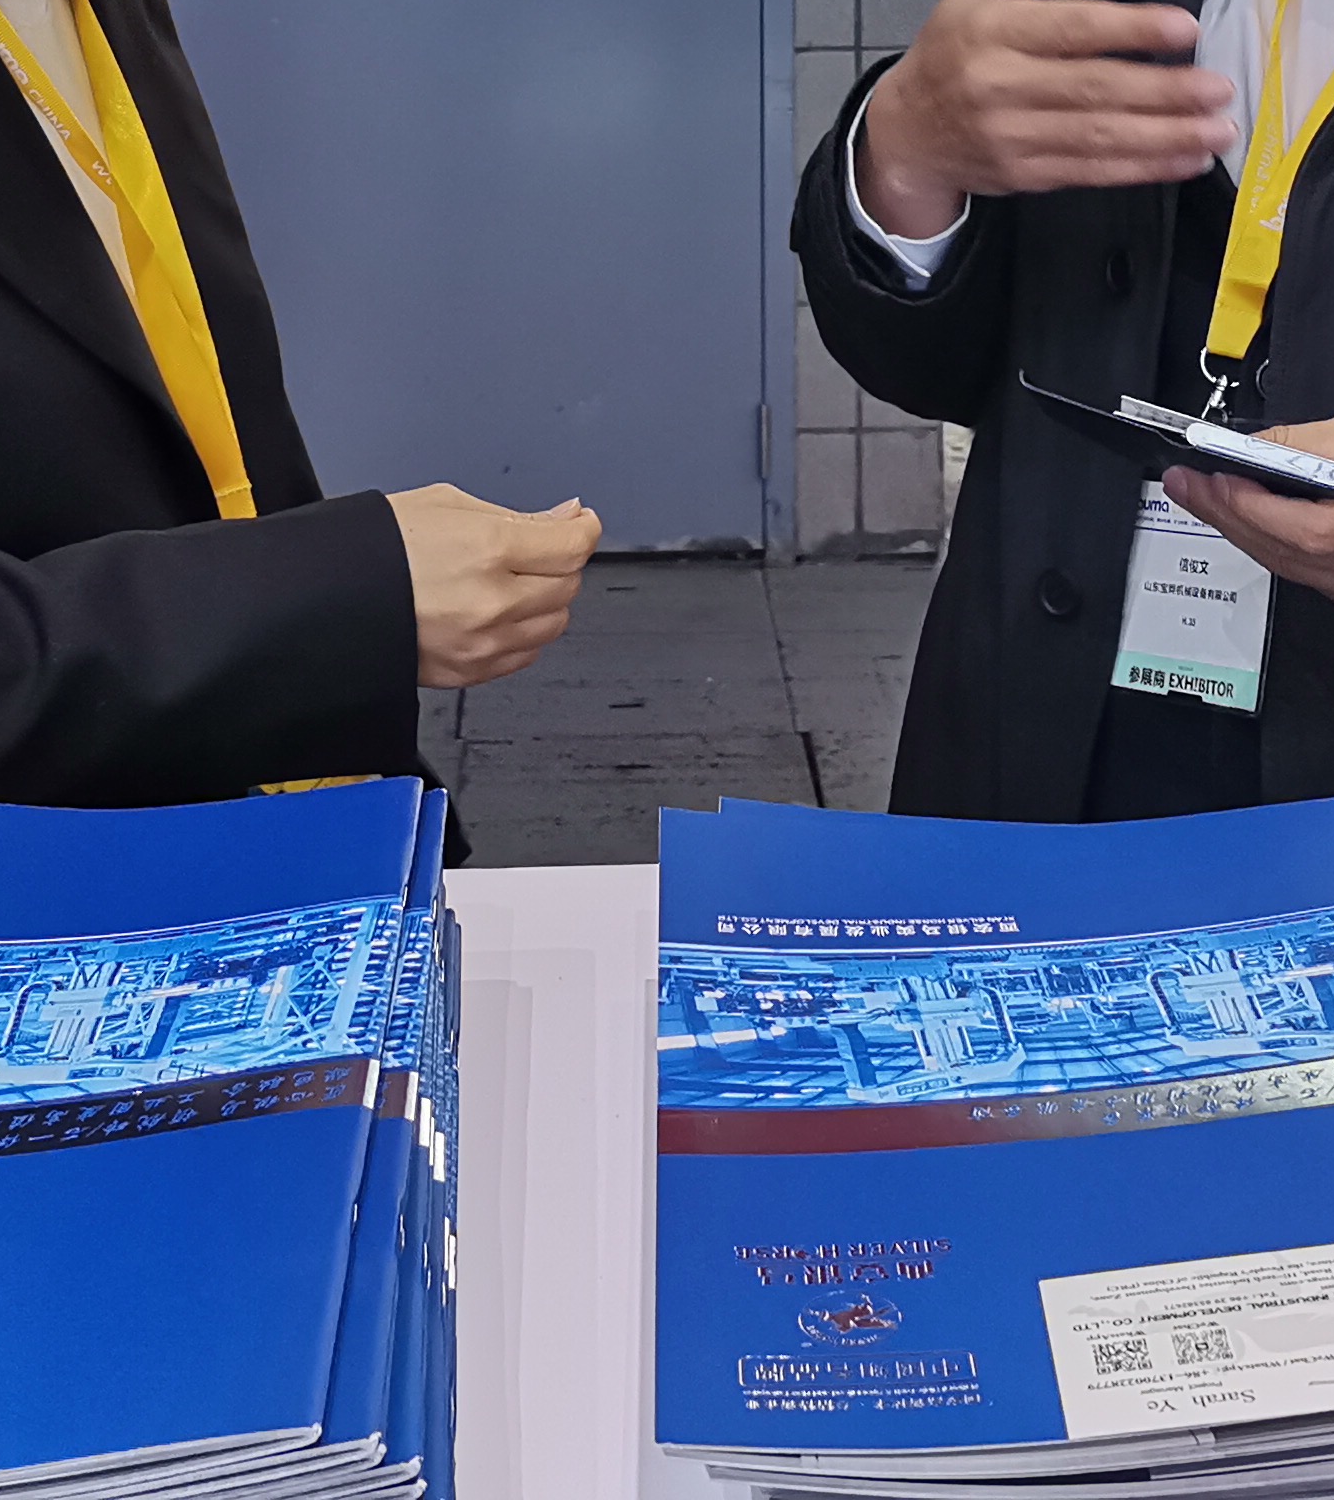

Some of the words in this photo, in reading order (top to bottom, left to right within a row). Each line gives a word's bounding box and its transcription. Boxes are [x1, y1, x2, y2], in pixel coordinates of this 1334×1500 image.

[29, 89, 71, 141] CHINA
[1128, 665, 1165, 688] 参展商
[1169, 671, 1235, 699] EXHIBITOR
[717, 922, 1020, 937] 西安银马实业发展有限公司
[848, 1239, 952, 1259] SILVER
[1247, 1292, 1330, 1310] INDUSTRIAL
[1138, 1301, 1244, 1324] DEVELOPMENT
[1190, 1388, 1256, 1409] Sarah
